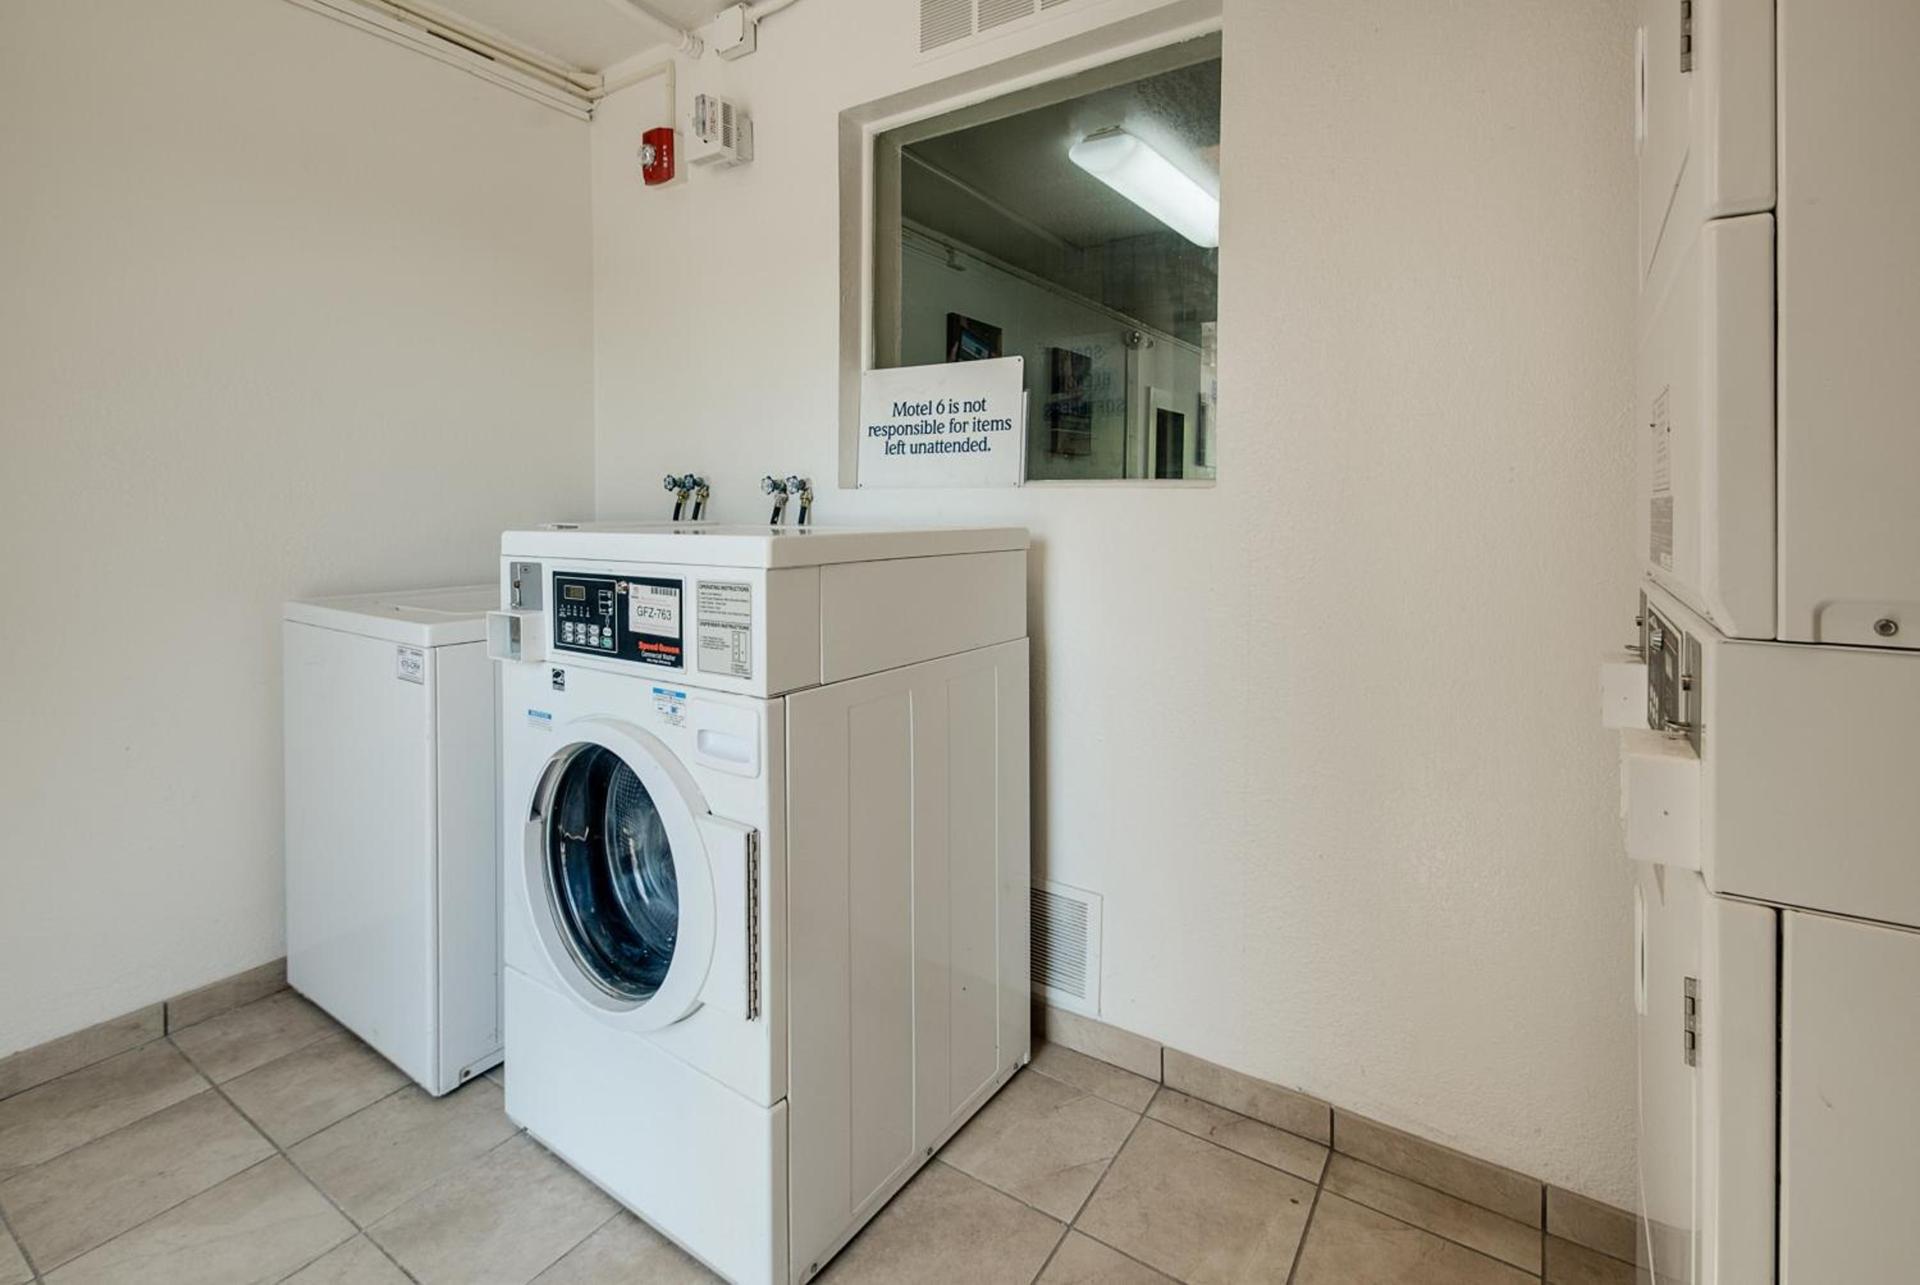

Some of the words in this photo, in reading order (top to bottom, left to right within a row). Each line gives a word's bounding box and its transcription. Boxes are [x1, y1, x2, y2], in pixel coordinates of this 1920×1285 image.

[892, 400, 932, 417] Motel
[936, 399, 945, 416] 6
[949, 398, 960, 413] is
[963, 397, 987, 413] not
[868, 420, 946, 440] responsible
[949, 418, 969, 434] for
[972, 417, 1012, 432] items
[884, 440, 906, 455] left
[910, 437, 991, 455] unattended.
[636, 604, 672, 621] GFZ-763
